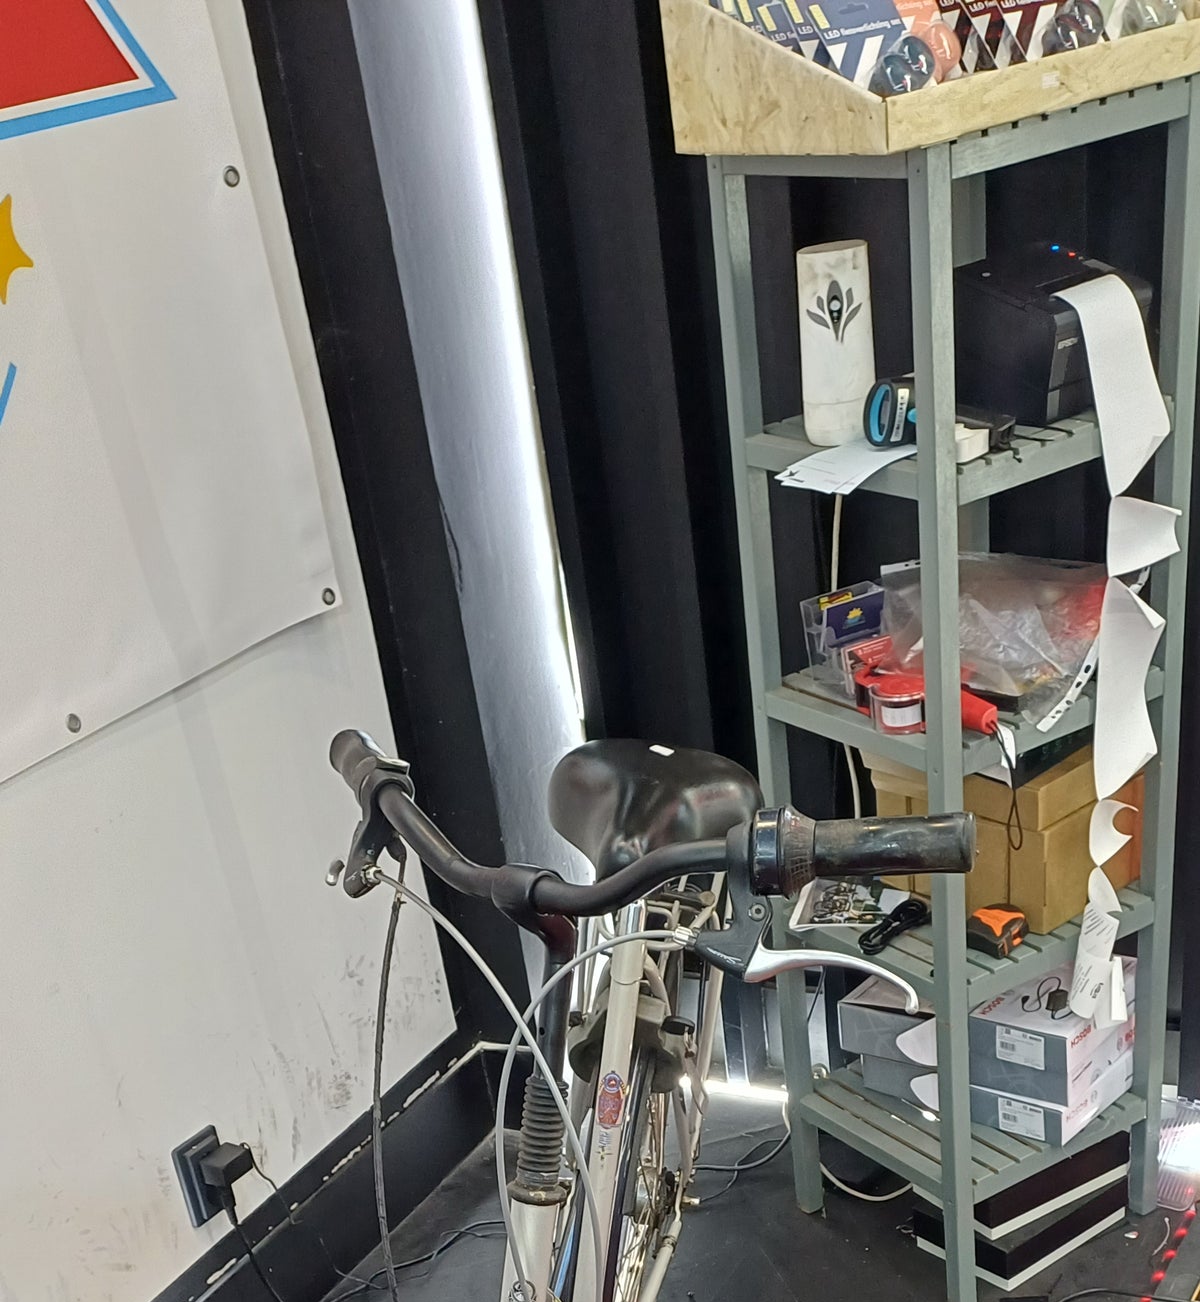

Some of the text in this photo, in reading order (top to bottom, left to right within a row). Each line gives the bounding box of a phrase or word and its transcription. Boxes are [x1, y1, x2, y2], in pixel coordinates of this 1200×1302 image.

[968, 3, 984, 12] LED
[799, 25, 813, 34] LED
[771, 31, 787, 41] LED
[824, 30, 840, 40] LED
